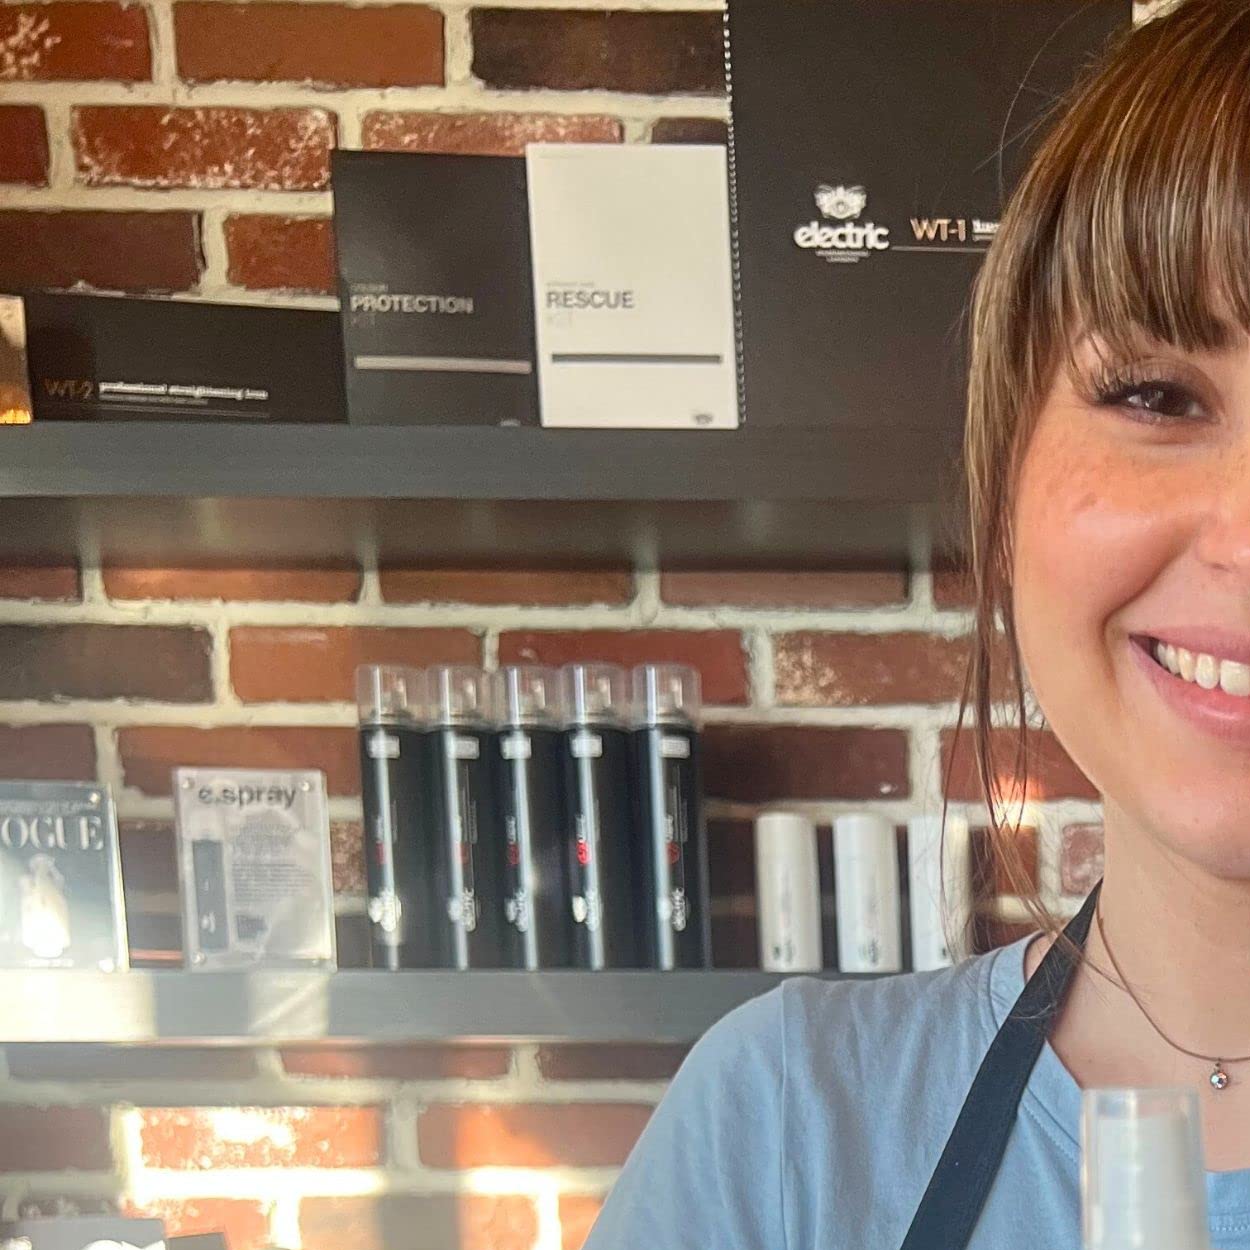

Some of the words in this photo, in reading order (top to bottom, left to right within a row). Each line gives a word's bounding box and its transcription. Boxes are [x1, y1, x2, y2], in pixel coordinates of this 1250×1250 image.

[794, 221, 889, 250] electric
[910, 217, 966, 242] WT-1
[350, 295, 474, 314] PROTECTION
[546, 290, 634, 309] RESCUE
[198, 783, 297, 810] e.spray
[0, 815, 105, 850] OGUE
